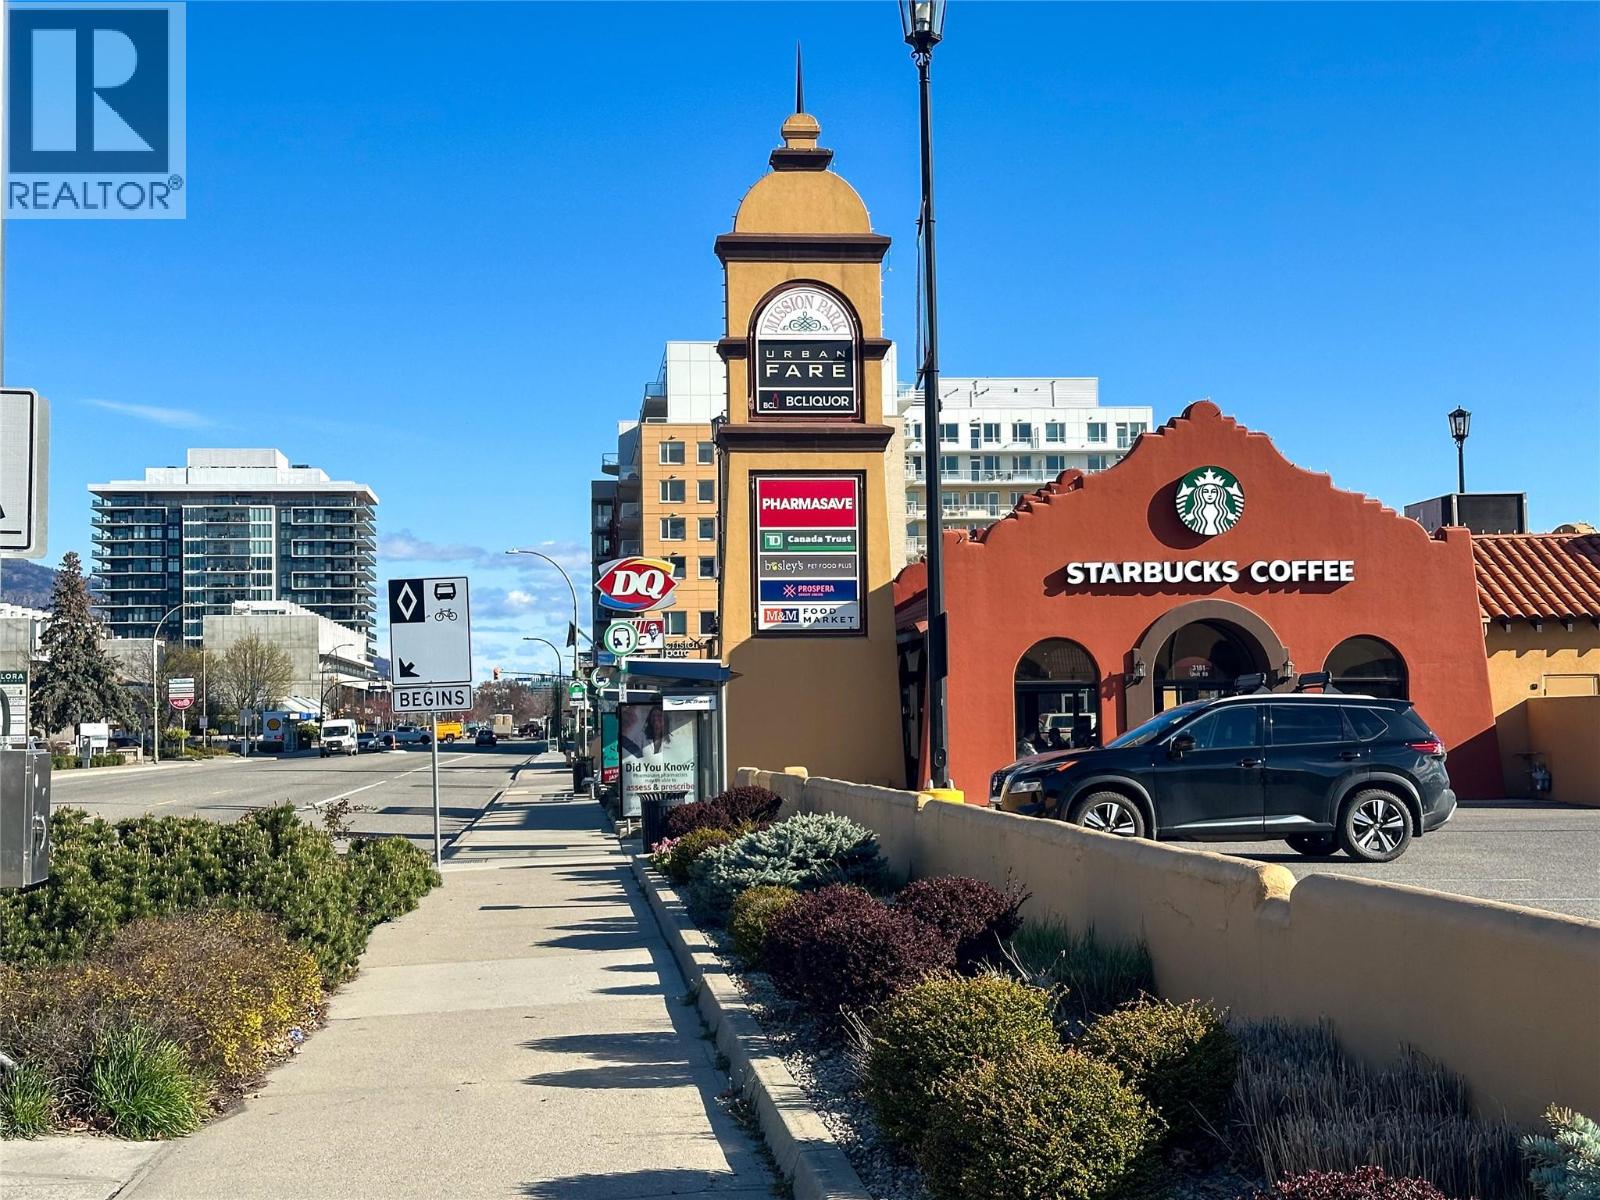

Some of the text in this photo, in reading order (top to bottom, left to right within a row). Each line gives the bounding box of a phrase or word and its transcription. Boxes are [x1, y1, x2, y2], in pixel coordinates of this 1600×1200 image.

[763, 294, 847, 333] MISSION PARK
[765, 350, 846, 358] URBAN
[765, 364, 846, 378] FARE
[785, 395, 850, 407] BCLIQUOR
[762, 497, 853, 510] PHARMASAVE
[767, 534, 852, 546] TD Canada Trust
[764, 559, 804, 574] bosley's
[1066, 559, 1355, 584] STARBUCKS COFFEE
[611, 569, 665, 600] DQ
[797, 584, 835, 593] PROSPERA
[765, 610, 798, 621] M&M
[399, 690, 465, 707] BEGINS
[625, 762, 695, 772] Did You Know?
[626, 783, 696, 791] assess & prescribe
